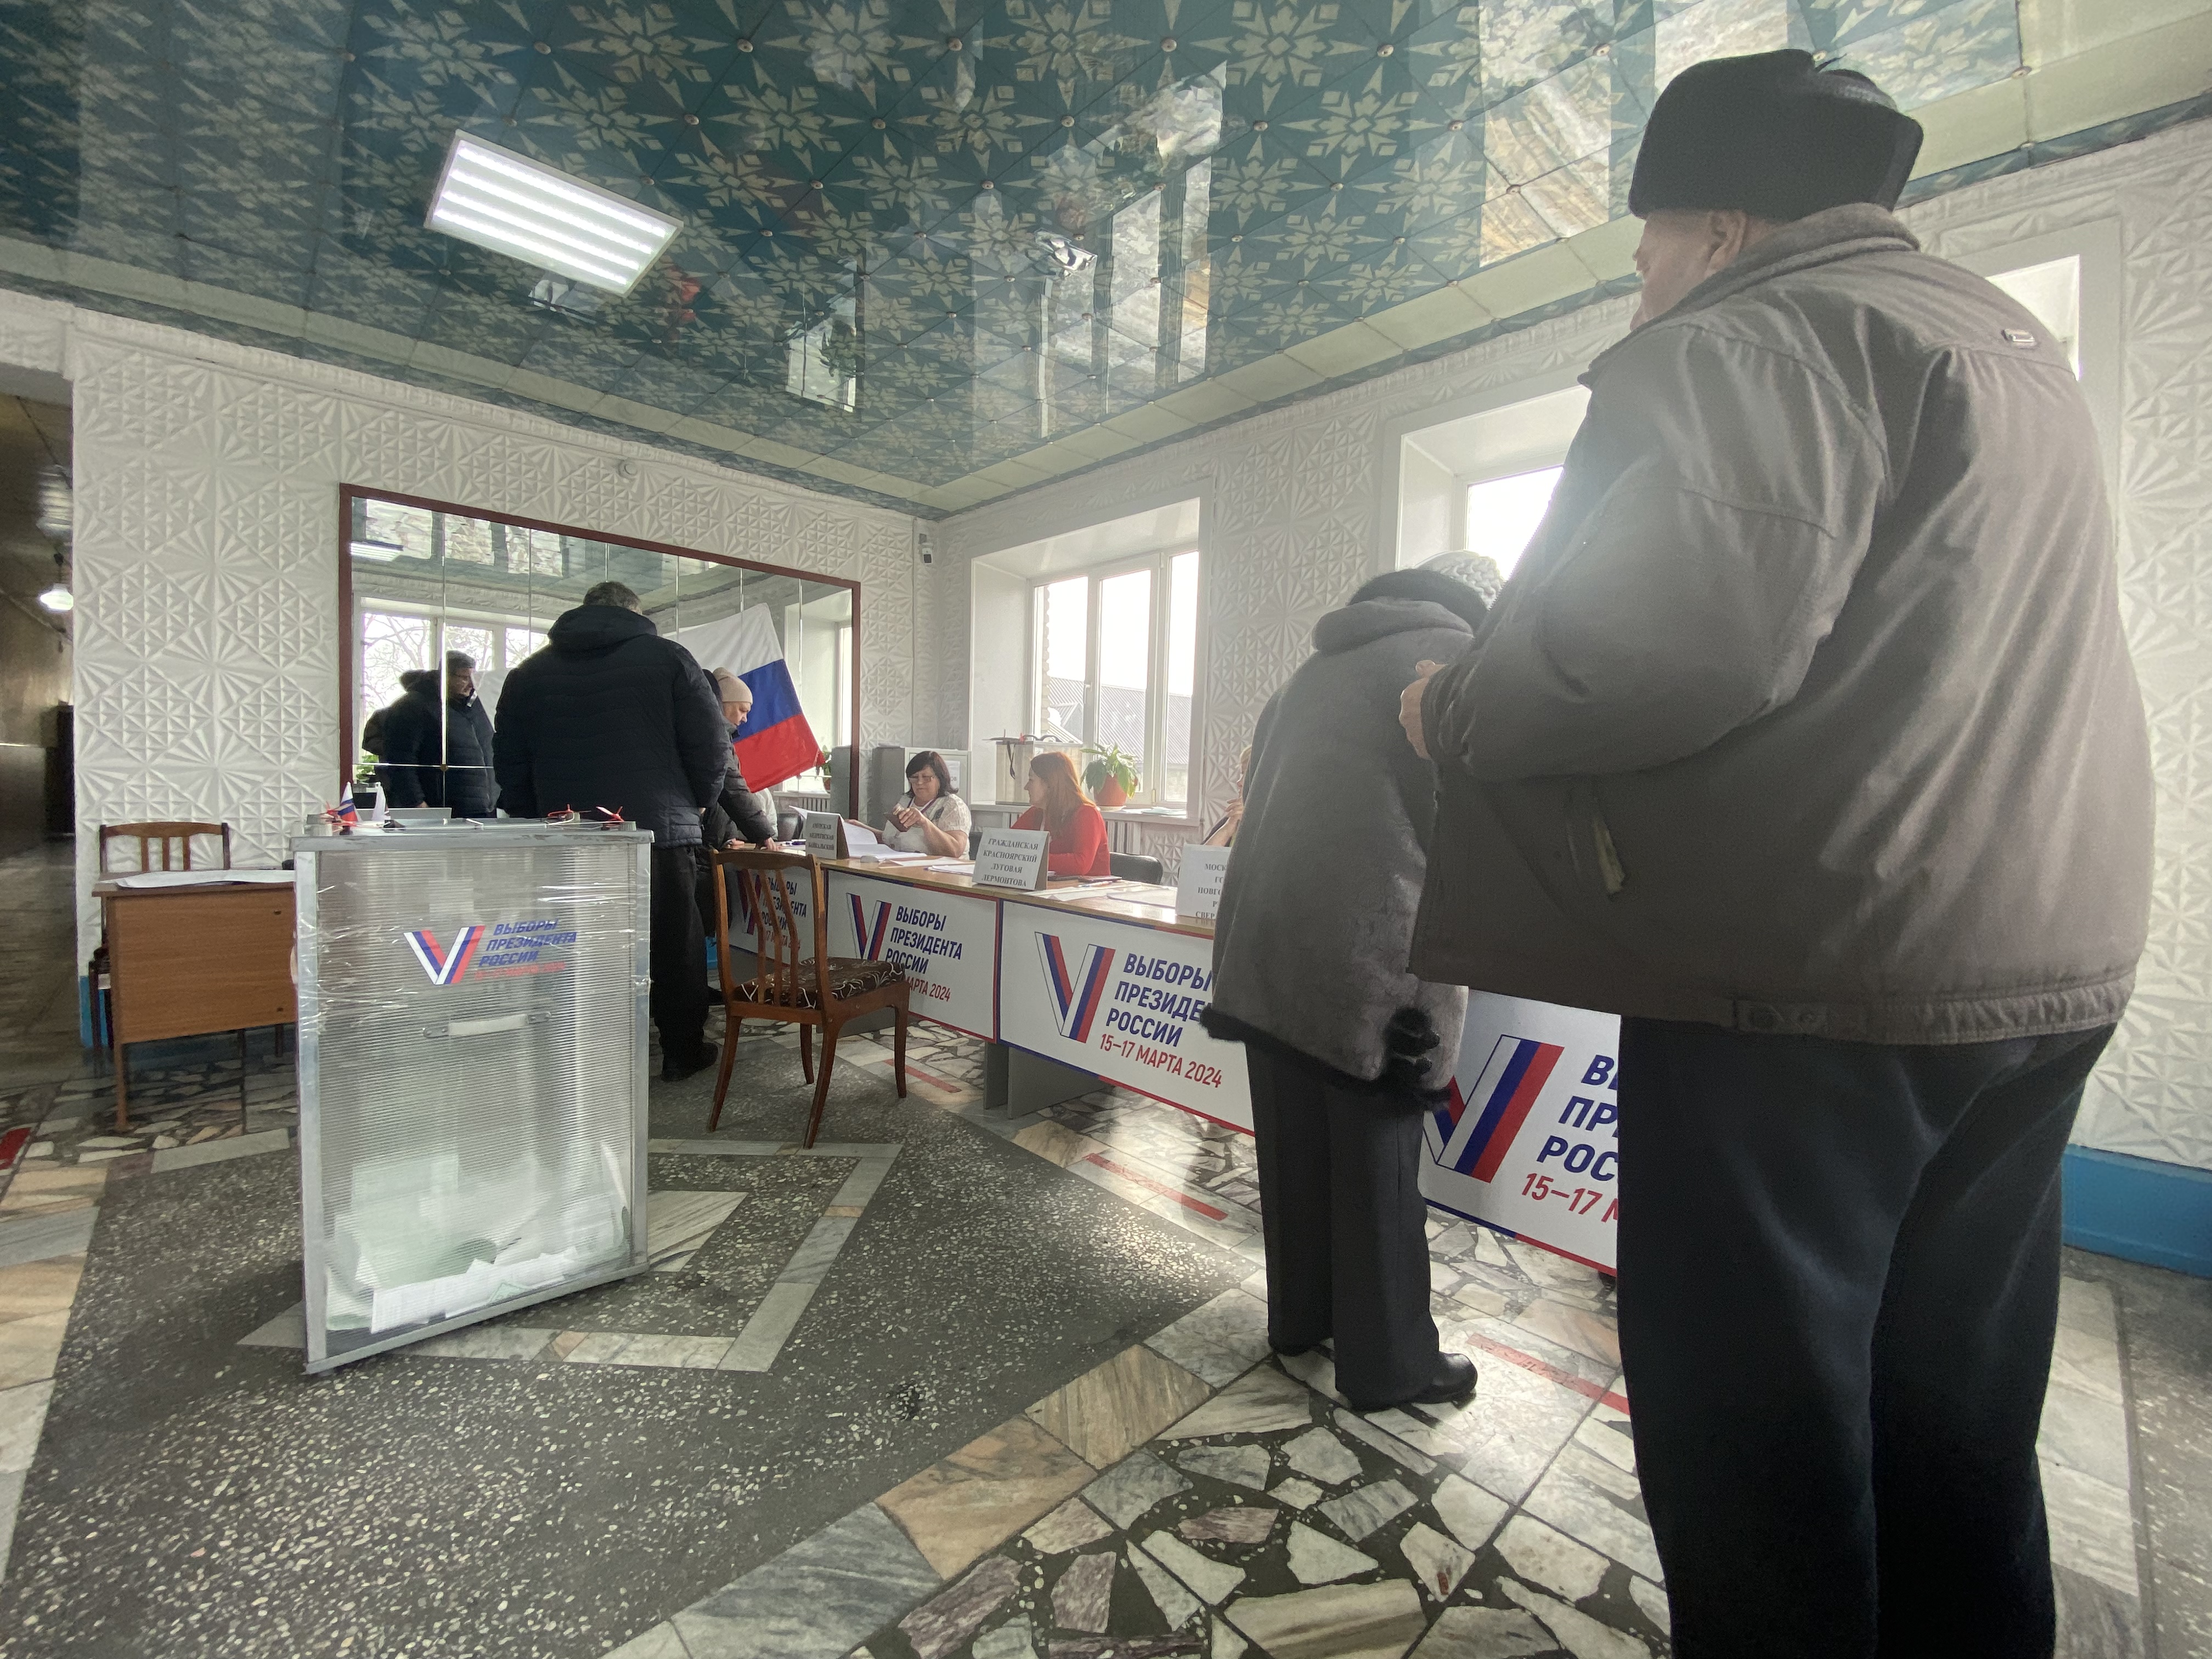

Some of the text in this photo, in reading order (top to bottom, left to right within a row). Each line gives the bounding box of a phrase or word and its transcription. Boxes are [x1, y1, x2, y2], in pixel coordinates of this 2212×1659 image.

[983, 850, 1037, 862] КРАСНОЯРСКИЙ
[988, 838, 1039, 850] ГРАЖДАНСКАЯ
[981, 874, 1026, 887] ЛЕРМОНТОВА
[990, 863, 1023, 873] ЛУГОВАЯ
[493, 918, 558, 936] ВЫБОРЫ
[895, 905, 947, 932] ВЫБОРЫ
[486, 932, 578, 951] ПРЕЗИДЕНТА
[890, 927, 963, 960] ПРЕЗИДЕНТА
[478, 950, 539, 967] РОССИИ
[885, 948, 929, 974] РОССИИ
[1124, 953, 1212, 991] ВЫБОРЫ
[929, 983, 951, 1002] 2024
[1114, 981, 1212, 1022] ПРЕЗИДЕ
[1106, 1008, 1183, 1047] РОССИИ
[1136, 1044, 1183, 1076] МАРТА
[1184, 1061, 1223, 1088] 2024
[1581, 1054, 1618, 1091] В
[1558, 1095, 1618, 1138] ПР
